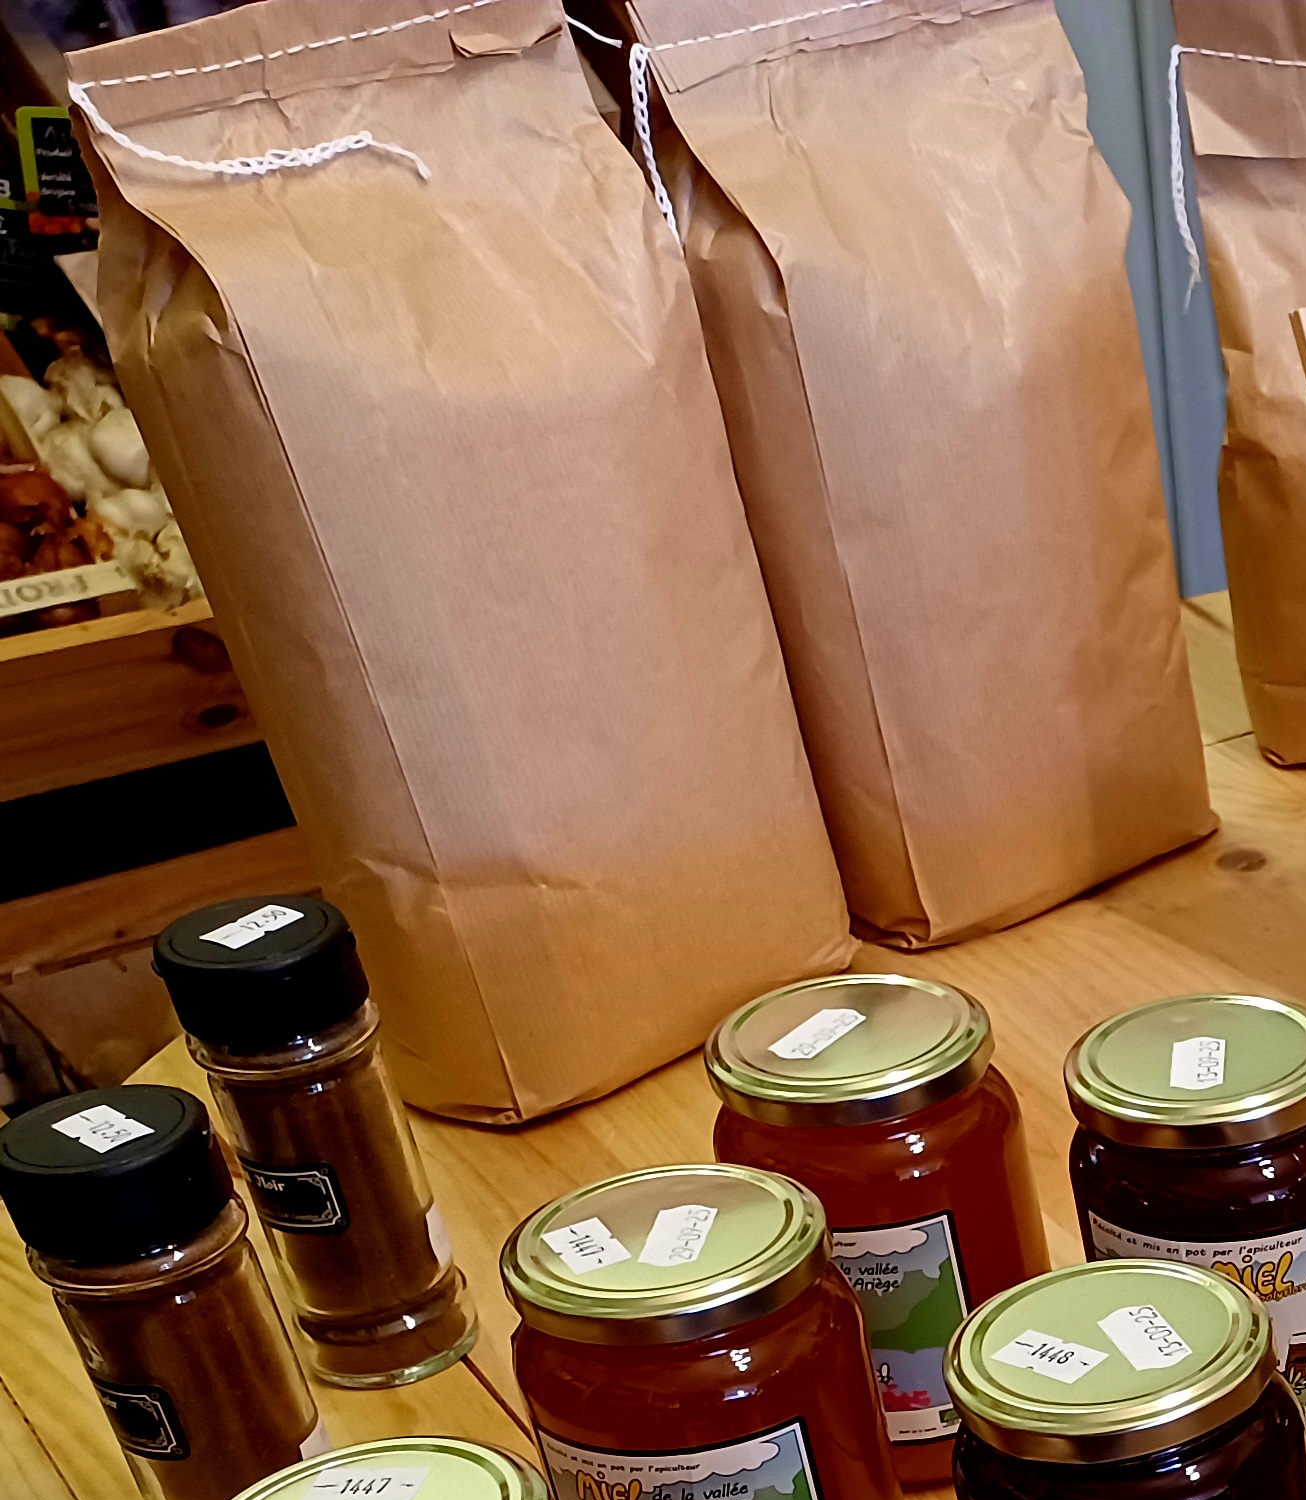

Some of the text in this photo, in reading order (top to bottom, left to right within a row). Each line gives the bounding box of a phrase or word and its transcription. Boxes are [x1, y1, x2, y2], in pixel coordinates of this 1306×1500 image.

[1032, 1342, 1075, 1365] 1448
[340, 1477, 392, 1496] 1447
[703, 1483, 748, 1500] vallée
